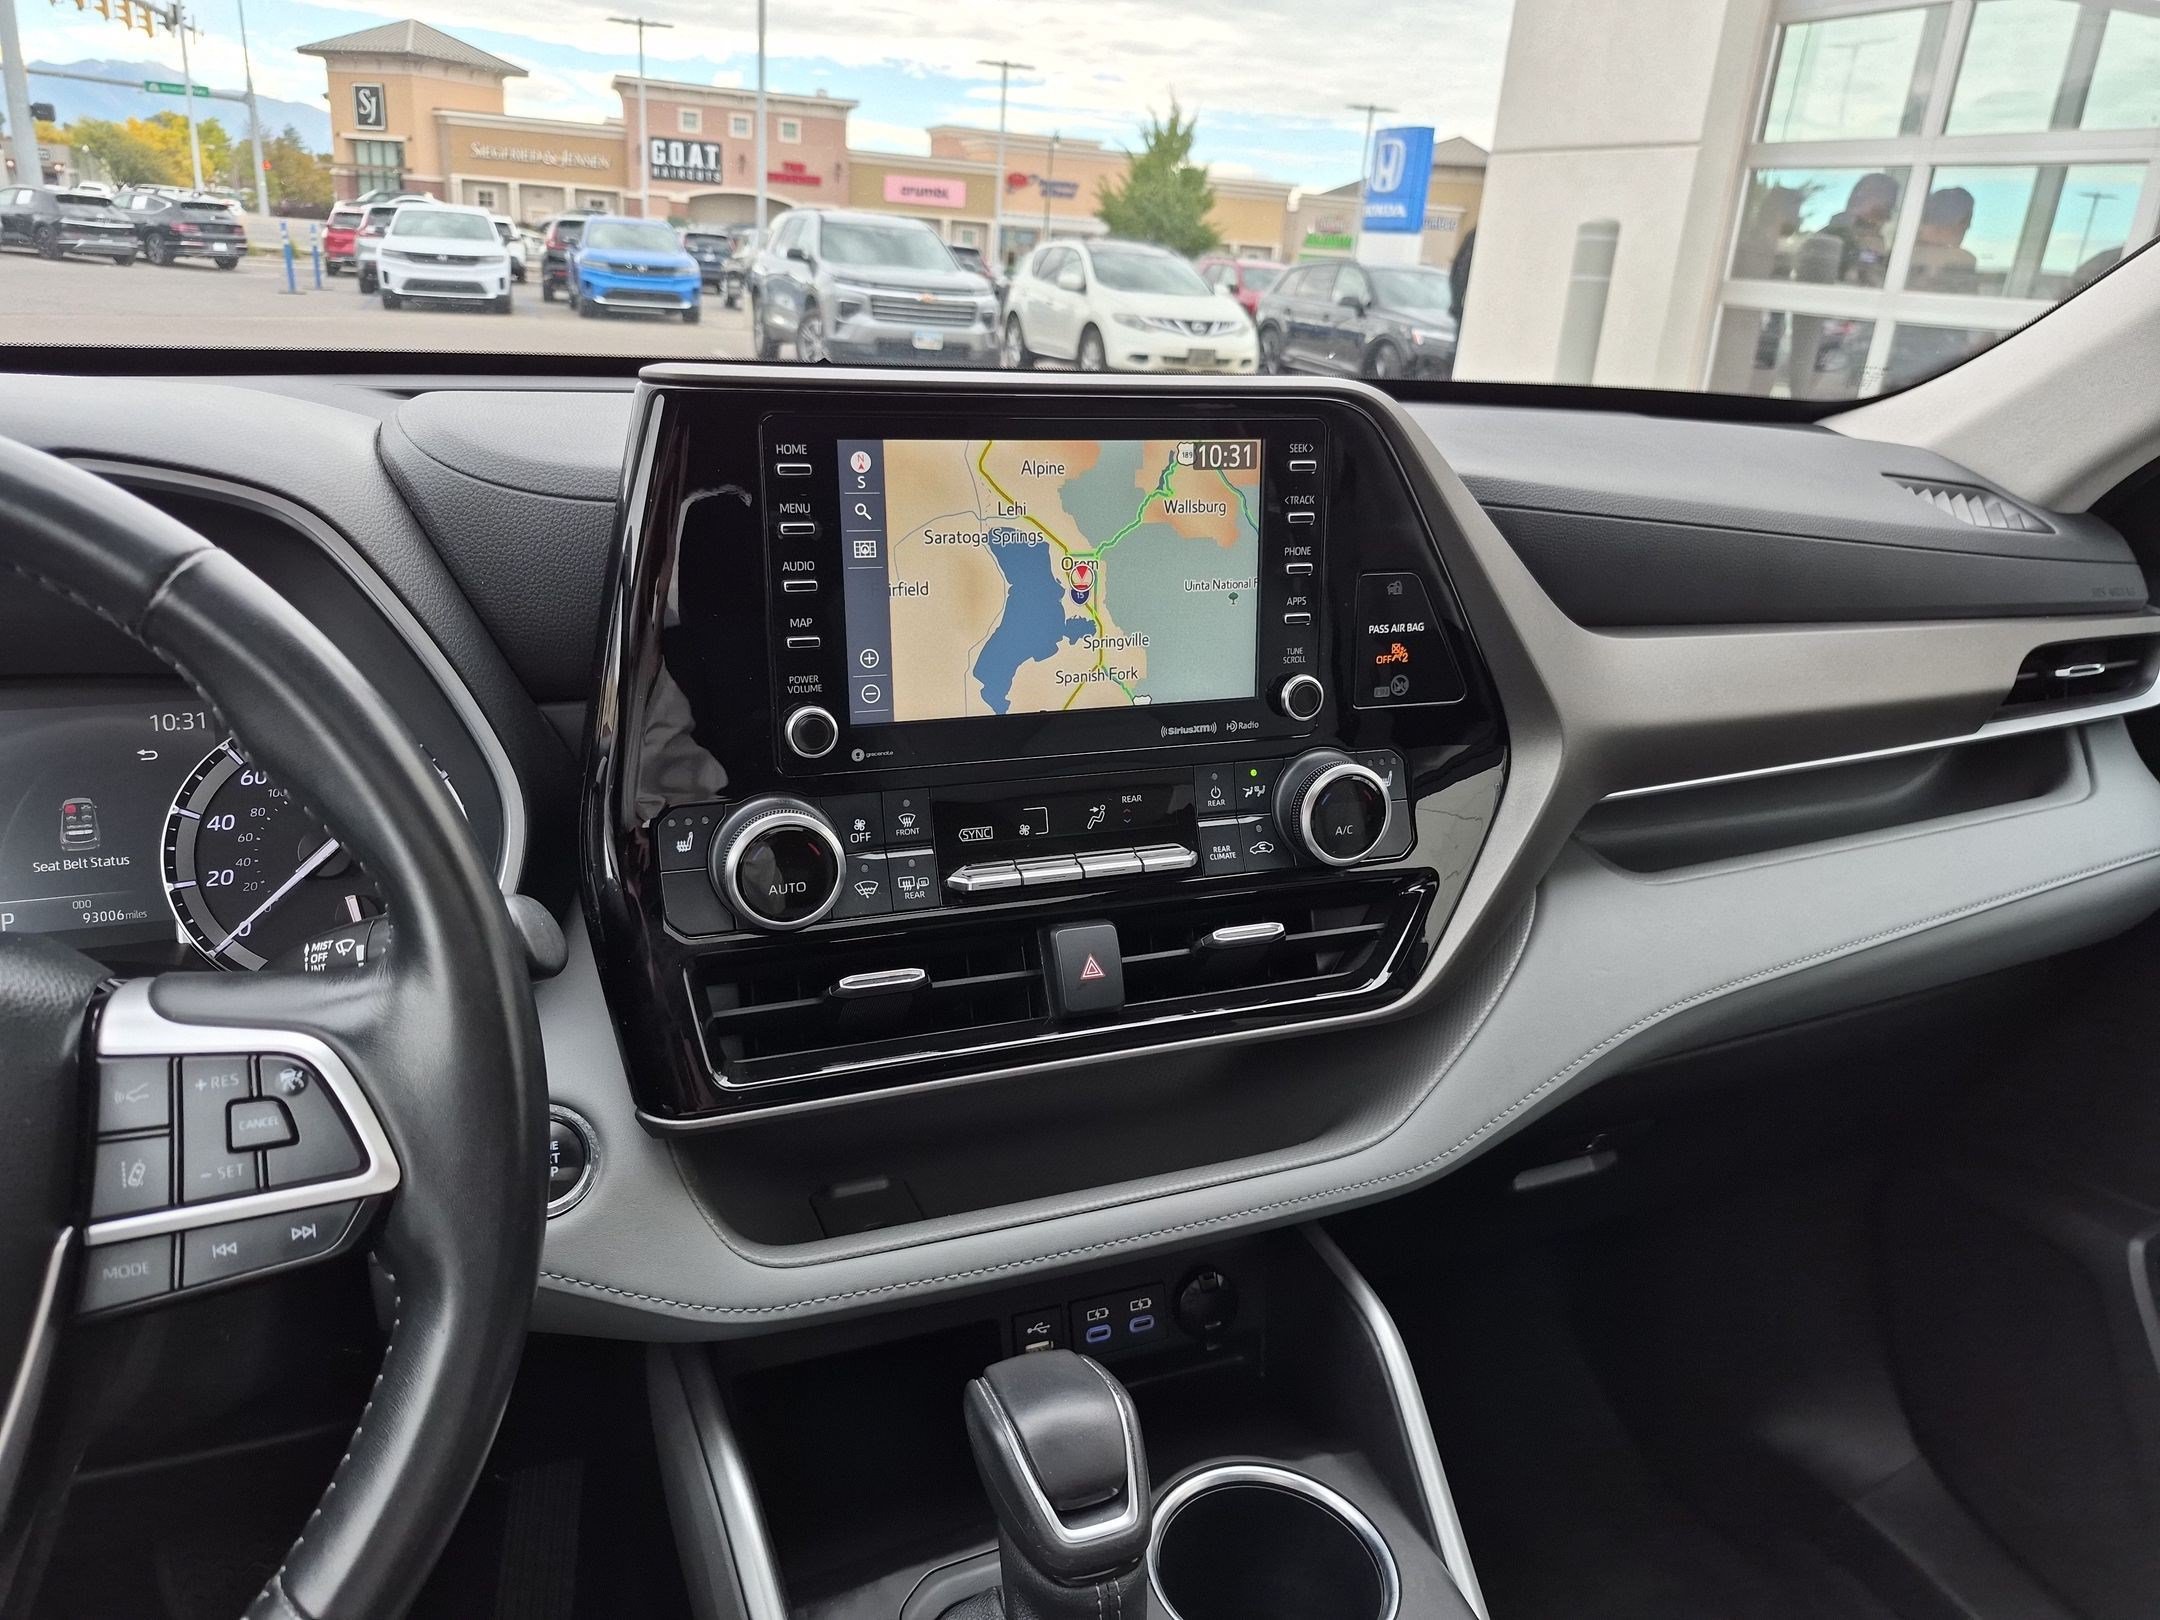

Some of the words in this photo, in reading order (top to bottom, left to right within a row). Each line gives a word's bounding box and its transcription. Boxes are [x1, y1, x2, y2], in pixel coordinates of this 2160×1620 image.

[776, 444, 808, 455] HOME
[1198, 444, 1251, 468] 10:31
[1021, 460, 1065, 478] Alpine
[857, 475, 866, 489] S
[779, 503, 811, 514] MENU
[998, 502, 1027, 516] Lehi
[1164, 499, 1227, 516] Wallsburg
[924, 529, 989, 547] Saratoga
[992, 529, 1044, 546] Springs
[1284, 546, 1312, 556] PHONE
[782, 561, 815, 571] AUDIO
[1184, 581, 1210, 591] Uinta
[1212, 578, 1251, 590] National
[1286, 596, 1307, 606] APPS
[789, 618, 813, 628] MAP
[1368, 625, 1389, 634] PASS
[1390, 623, 1406, 633] AIR
[1406, 622, 1425, 632] BAG
[1083, 633, 1150, 651] Springville
[1286, 647, 1304, 655] TUNE
[1282, 656, 1306, 664] SCROLL
[1375, 655, 1392, 664] OFF
[788, 675, 819, 684] POWER
[1055, 670, 1105, 687] Spanish
[1109, 666, 1138, 681] Fork
[787, 684, 823, 694] VOLUME
[150, 712, 207, 732] 10:31
[1238, 721, 1260, 731] Radio
[240, 770, 267, 786] 60
[1121, 794, 1143, 804] REAR
[1207, 799, 1226, 807] REAR
[250, 808, 266, 818] 80
[206, 814, 235, 831] 40
[895, 827, 920, 836] FRONT
[962, 828, 991, 840] SYNC
[1335, 825, 1354, 836] A/C
[237, 832, 253, 843] 60
[850, 832, 872, 844] OFF
[1212, 845, 1231, 854] REAR
[1209, 851, 1237, 861] CLIMATE
[33, 861, 61, 873] Seat
[63, 858, 89, 871] Belt
[90, 855, 130, 868] Status
[235, 857, 251, 867] 40
[206, 869, 234, 887] 20
[242, 882, 258, 892] 20
[769, 882, 807, 896] AUTO
[904, 890, 926, 900] REAR
[72, 900, 92, 909] ODO
[1, 913, 15, 932] P
[82, 910, 125, 924] 93006
[125, 910, 148, 919] miles
[310, 940, 334, 952] MIST
[310, 952, 329, 964] OFF
[239, 1115, 279, 1130] CANCEL
[102, 1261, 149, 1280] MODE
